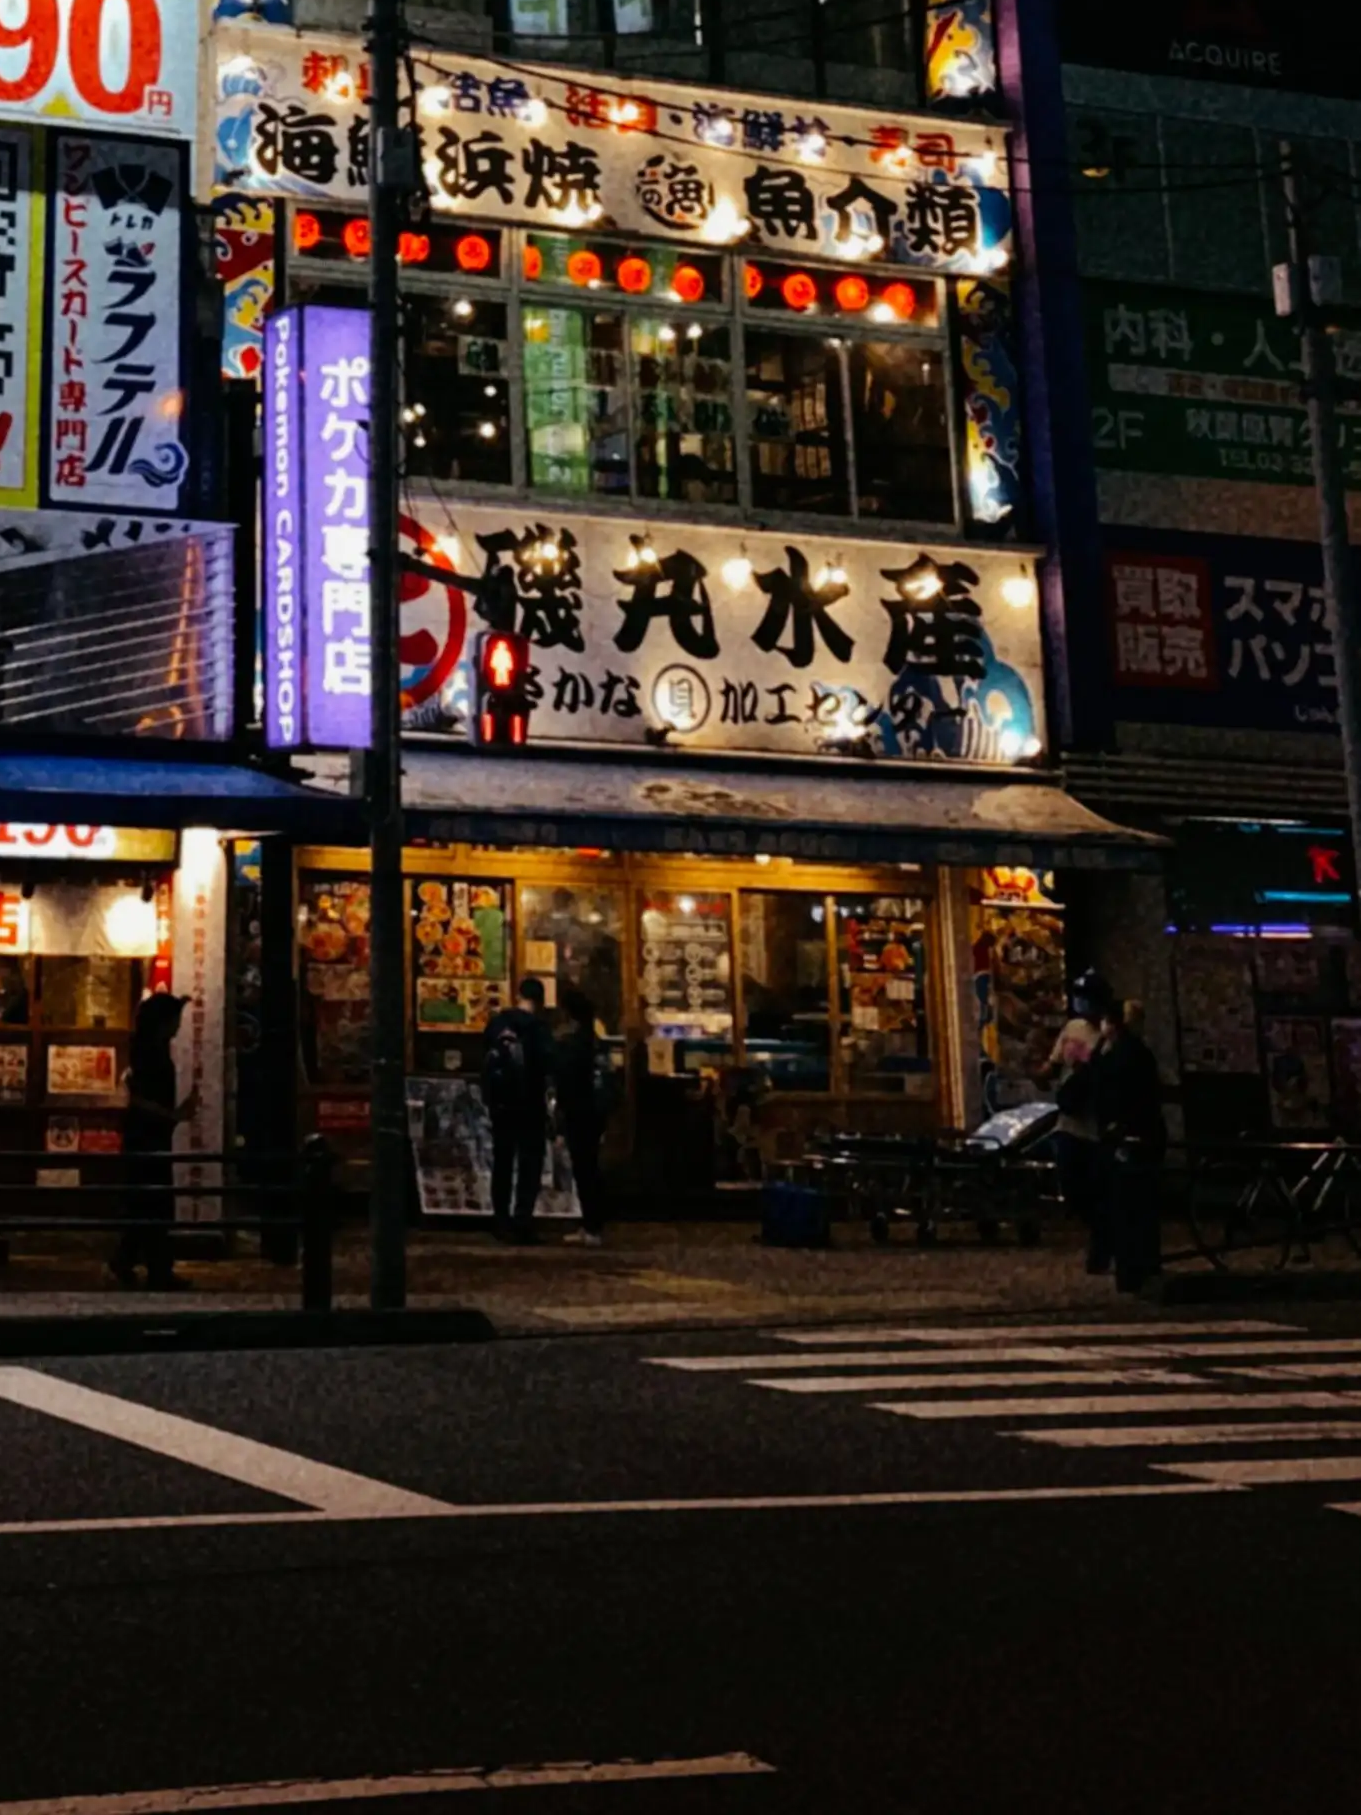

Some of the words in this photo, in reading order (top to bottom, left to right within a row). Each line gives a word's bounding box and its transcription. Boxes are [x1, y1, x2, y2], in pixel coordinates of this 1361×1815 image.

[1167, 37, 1283, 79] ACQUIRE
[53, 142, 89, 489] ワンピースカード専門店
[319, 356, 371, 695] ポケカ専門店
